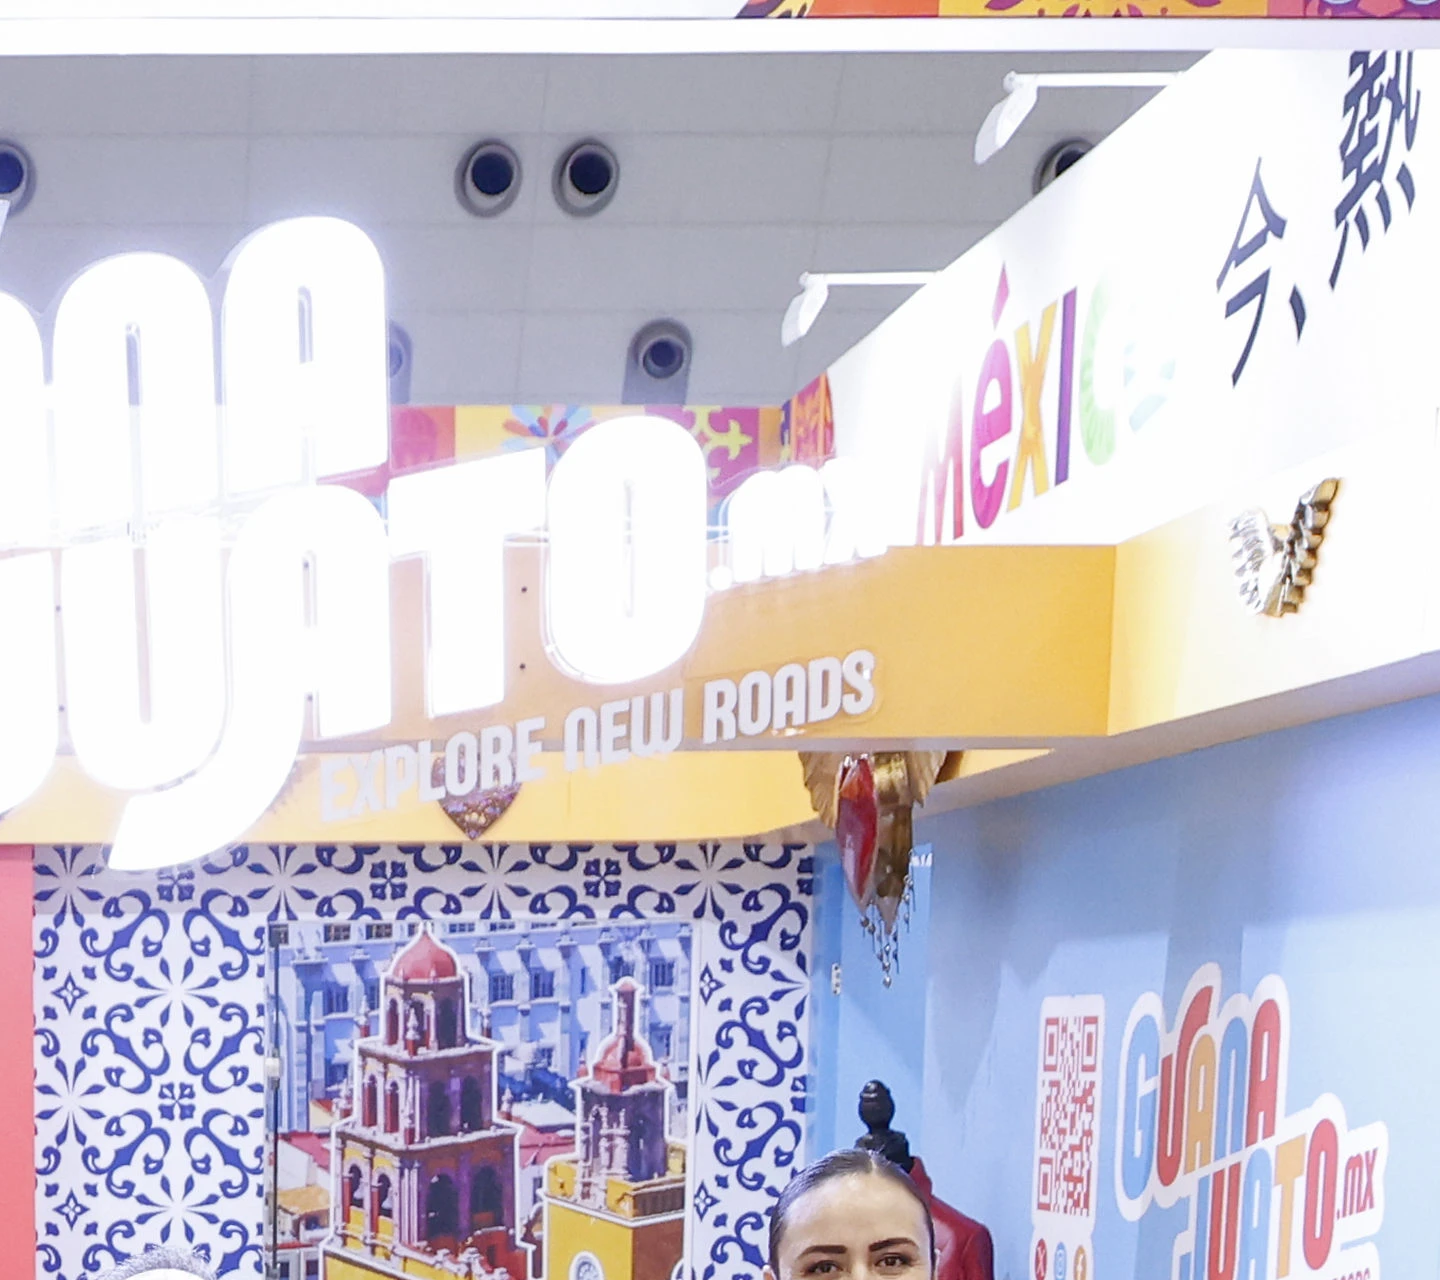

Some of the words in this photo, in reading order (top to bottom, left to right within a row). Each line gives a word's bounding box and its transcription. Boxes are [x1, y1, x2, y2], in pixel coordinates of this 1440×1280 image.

[322, 716, 546, 822] EXPLORE
[564, 688, 685, 771] NEW
[703, 649, 876, 744] ROADS
[1120, 985, 1281, 1201] GUANA
